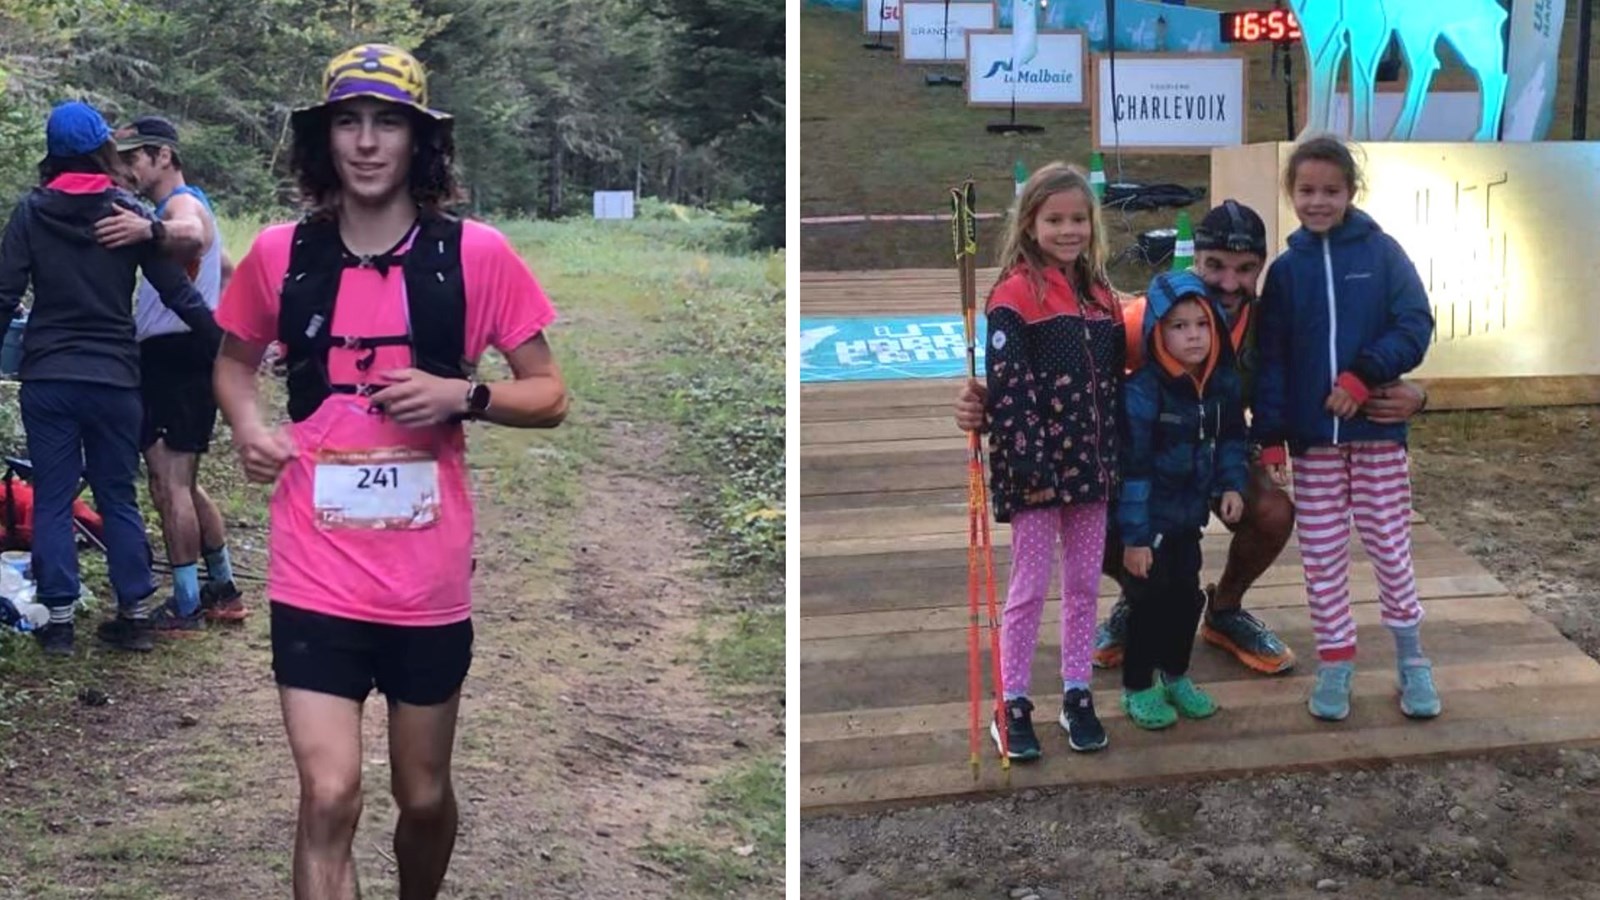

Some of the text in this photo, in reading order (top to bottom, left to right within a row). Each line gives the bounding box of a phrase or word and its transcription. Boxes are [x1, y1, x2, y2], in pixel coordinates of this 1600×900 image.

[1017, 68, 1073, 84] Malbaie
[1116, 93, 1226, 121] CHARLEVOIX
[356, 466, 398, 489] 241
